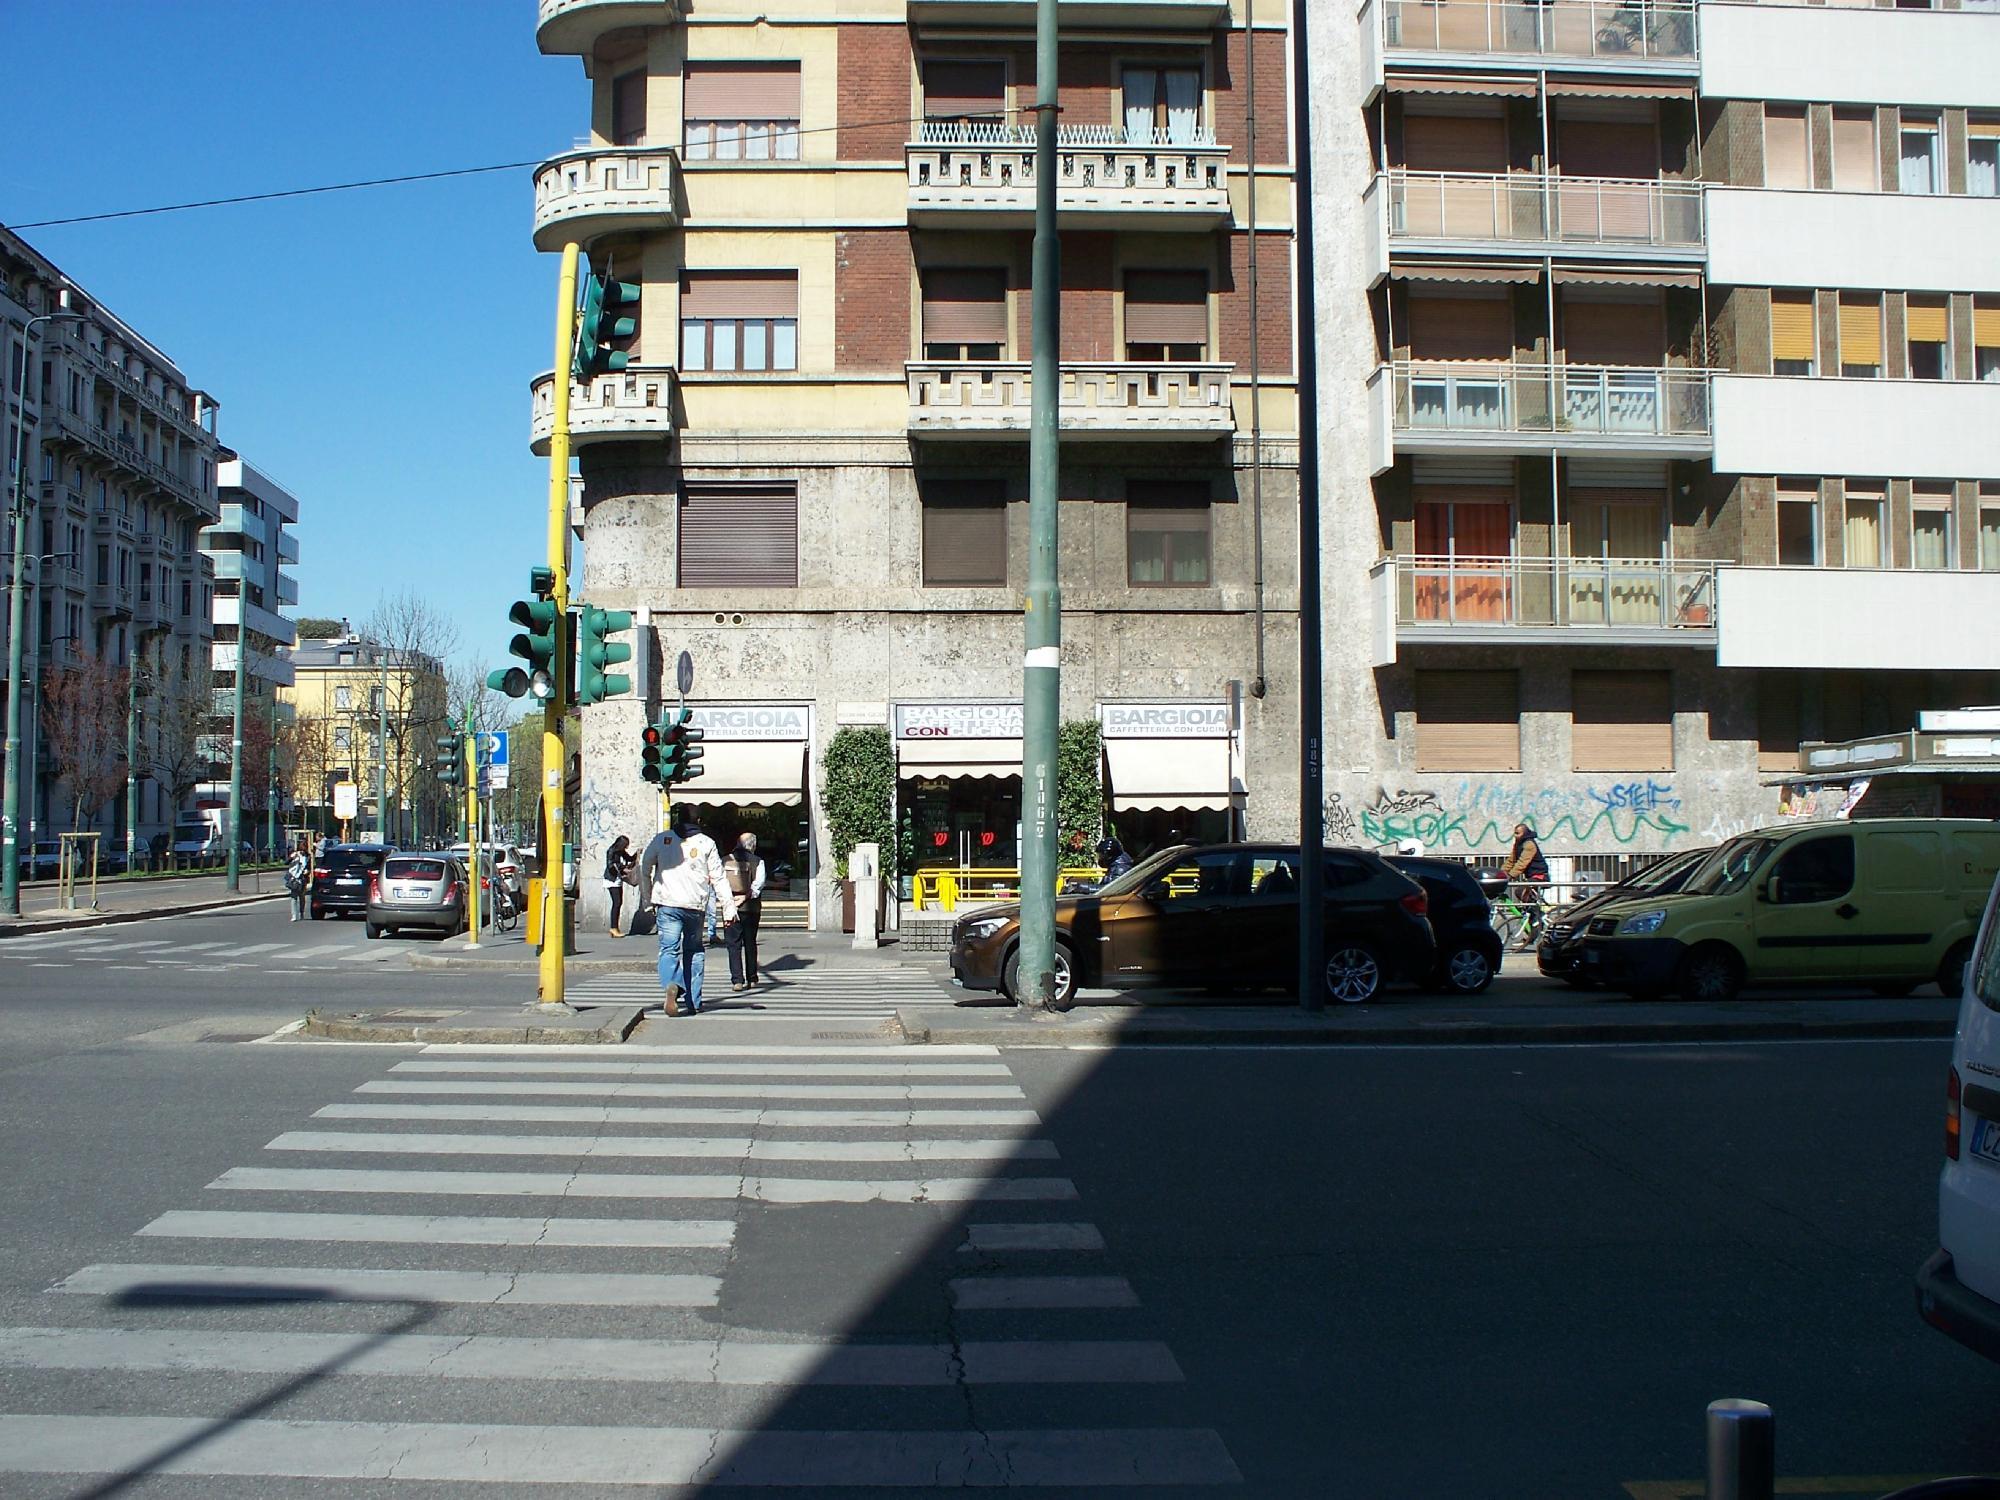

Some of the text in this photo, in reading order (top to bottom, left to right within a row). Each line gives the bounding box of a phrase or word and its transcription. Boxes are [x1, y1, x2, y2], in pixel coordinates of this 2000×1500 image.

[904, 707, 1023, 719] BARGIOIA
[1109, 709, 1228, 725] BARGIOIA
[905, 727, 1023, 736] CON CUCINA
